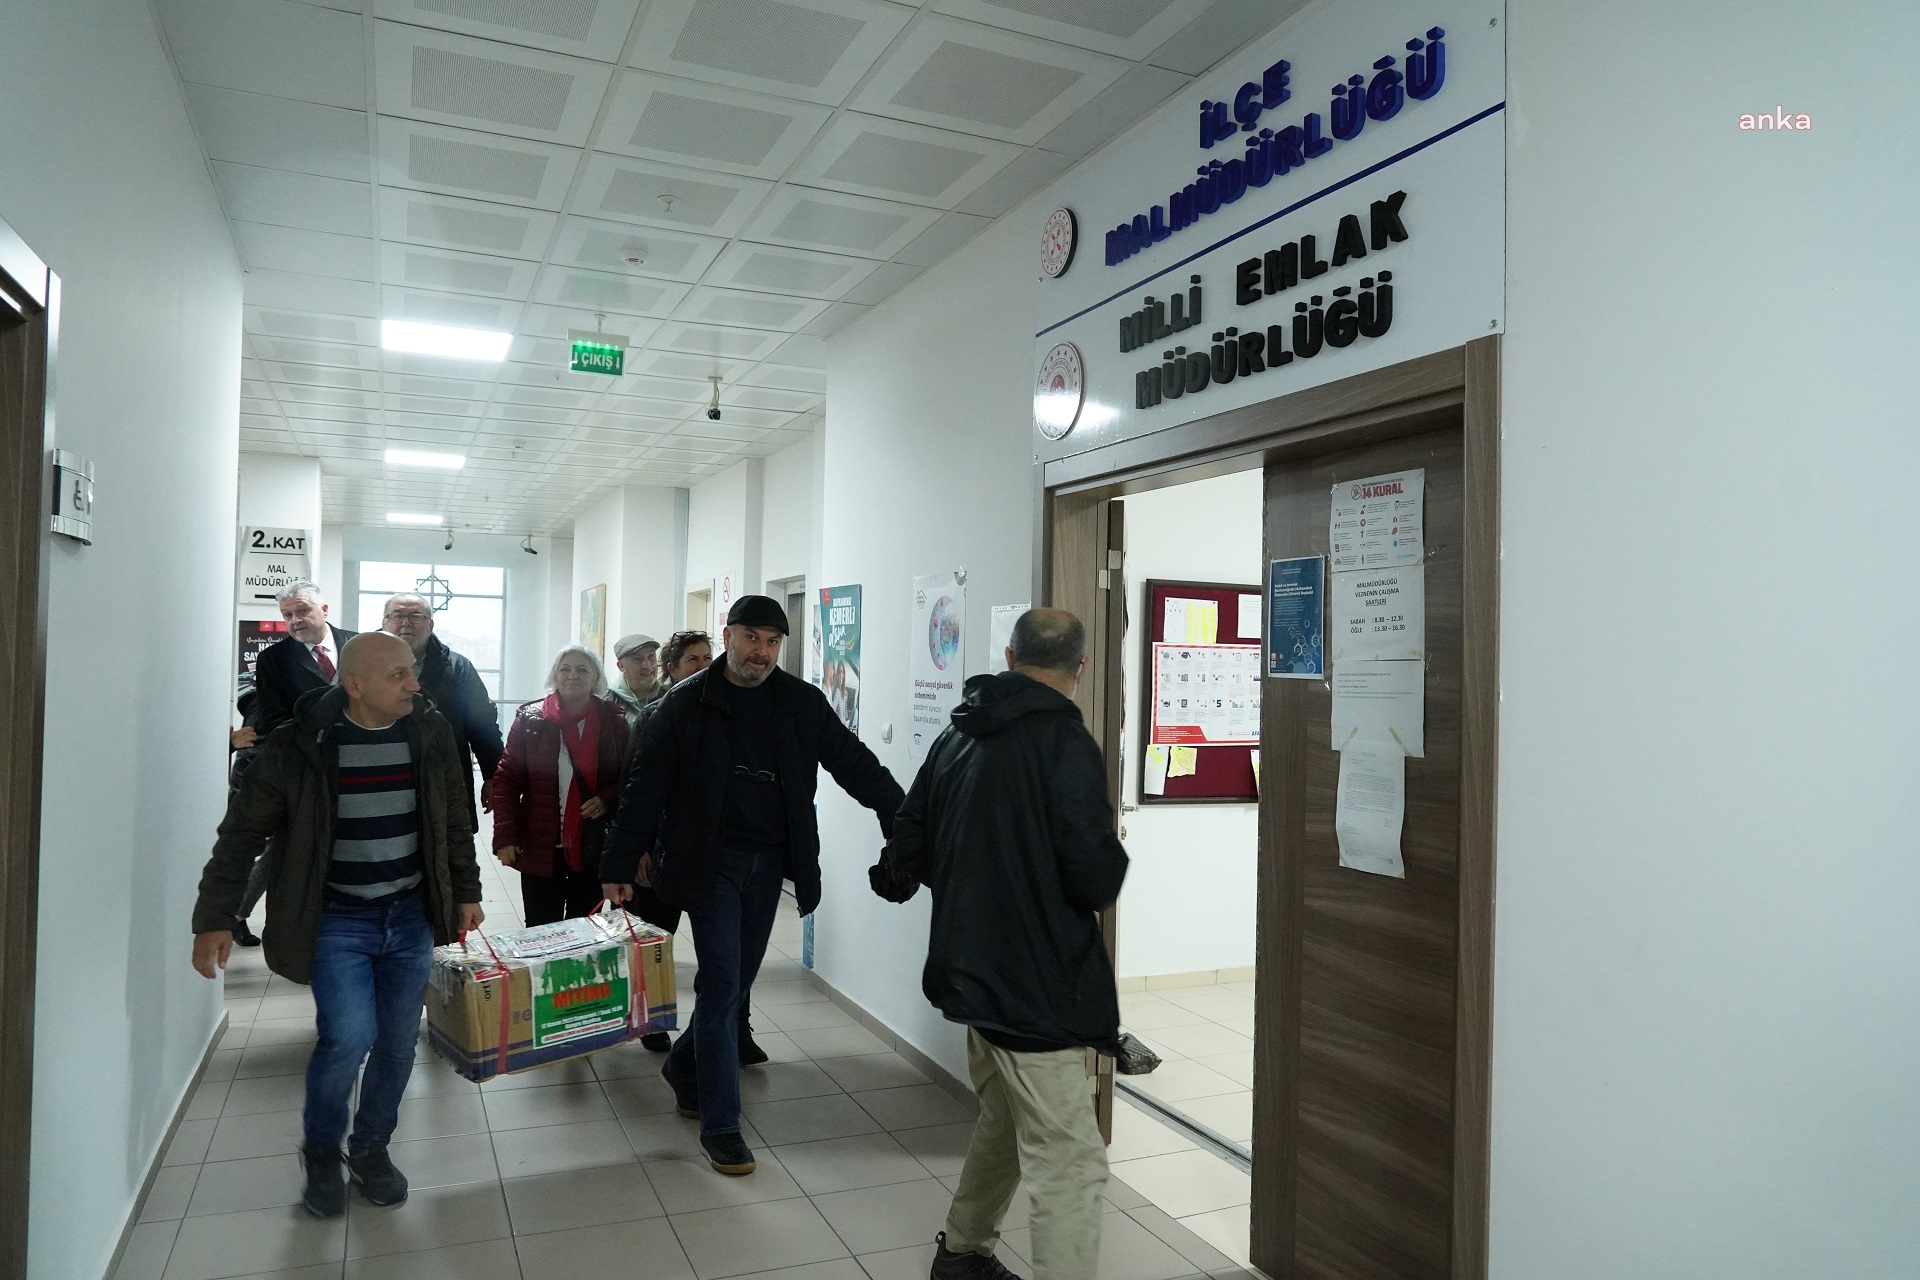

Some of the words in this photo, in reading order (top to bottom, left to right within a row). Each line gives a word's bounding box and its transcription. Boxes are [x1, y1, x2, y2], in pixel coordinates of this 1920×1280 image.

[1200, 59, 1291, 149] İLÇE
[1105, 26, 1446, 266] MALMÜDÜRLÜĞÜ
[1120, 274, 1202, 353] MİLLİ
[1236, 190, 1408, 306] EMLAK
[1136, 270, 1393, 409] MÜDÜRLÜĞÜ
[581, 352, 613, 370] ÇIKIŞ
[1362, 486, 1373, 499] 14
[1373, 483, 1403, 498] KURAL
[267, 564, 287, 574] MAL
[245, 574, 306, 587] MÜDÜRLÜ
[1356, 578, 1398, 588] MALMÜDÜRLÜĞÜ
[1354, 590, 1378, 598] VEZNENİN
[1378, 588, 1400, 596] ÇALIŞMA
[1365, 597, 1387, 606] SAATLERİ
[1391, 614, 1404, 622] 12.30
[553, 982, 611, 1009] MİTİNG
